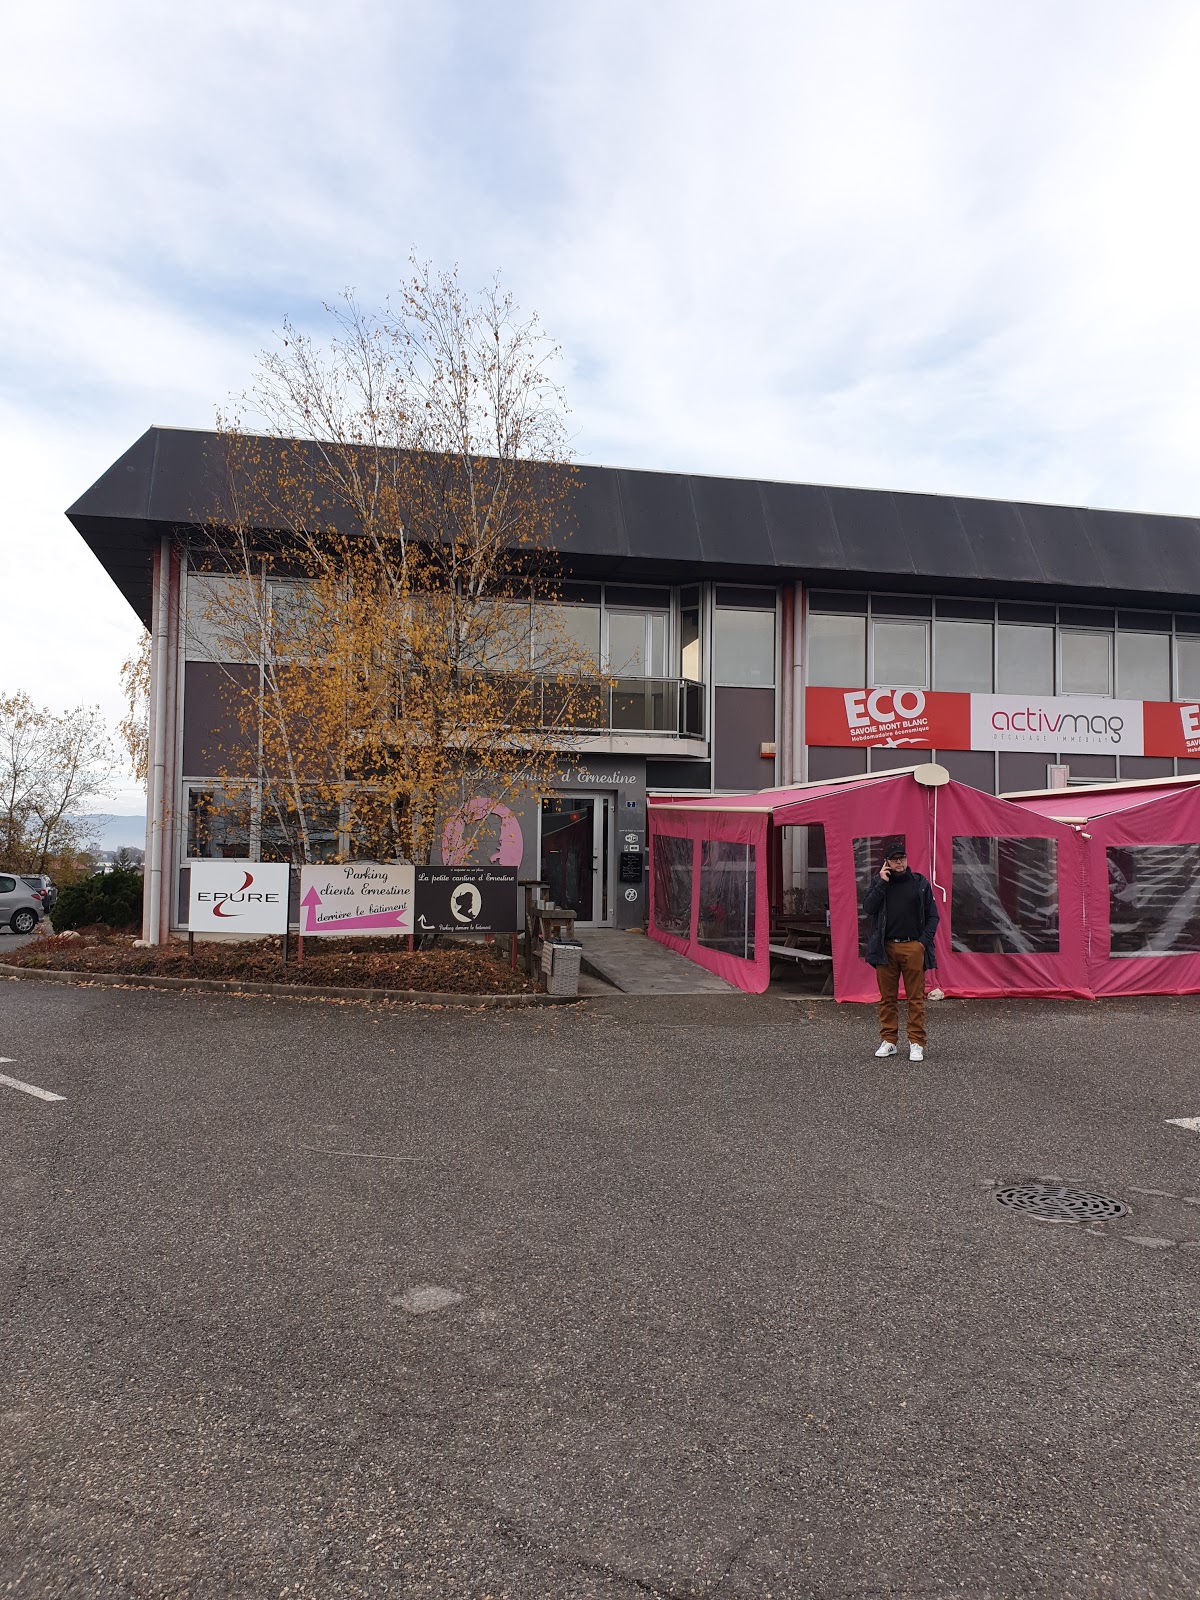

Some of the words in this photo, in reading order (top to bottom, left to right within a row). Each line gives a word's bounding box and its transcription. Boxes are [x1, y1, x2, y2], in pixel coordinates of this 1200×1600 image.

[843, 687, 926, 728] ECO
[850, 725, 878, 736] SAVOIE
[879, 721, 901, 732] MONT
[902, 717, 928, 728] BLANC
[991, 707, 1124, 744] activmag
[1179, 704, 1200, 740] E
[851, 731, 893, 742] Hebdomadaire
[894, 726, 930, 737] économique
[1185, 739, 1200, 748] SAV
[561, 765, 637, 784] d'Ernestine
[344, 867, 389, 884] Parking
[418, 872, 429, 882] La
[431, 874, 450, 884] petite
[452, 874, 476, 882] cantine
[478, 872, 515, 882] d'Ernestine
[197, 891, 280, 903] EPURE
[320, 883, 355, 896] clients
[361, 882, 411, 896] Ernestine
[317, 910, 352, 923] derrière
[356, 905, 365, 916] le
[369, 901, 407, 914] bâtiment
